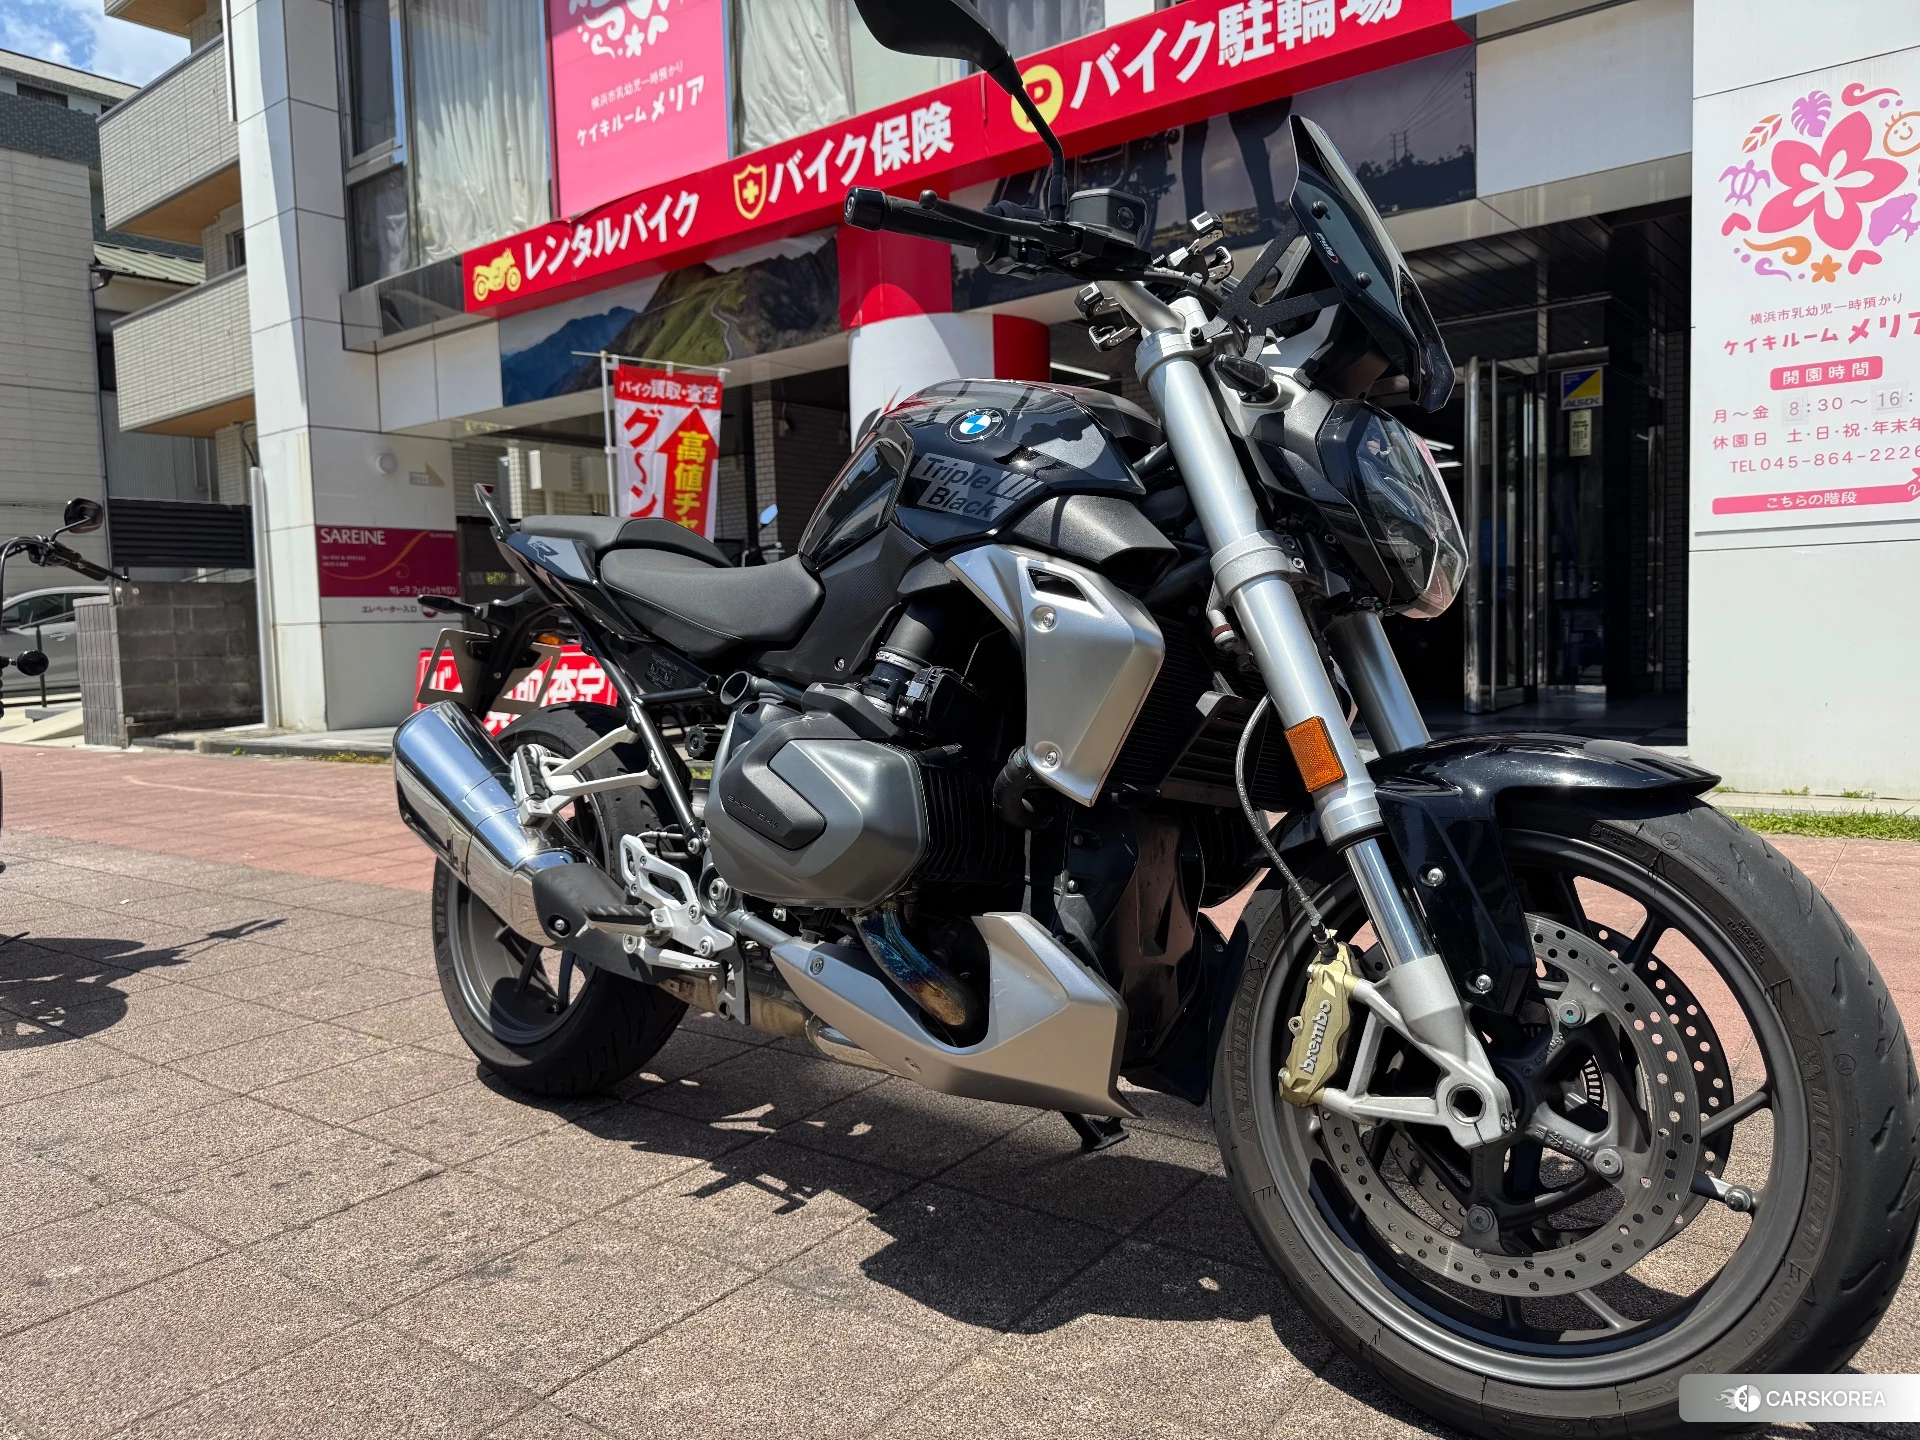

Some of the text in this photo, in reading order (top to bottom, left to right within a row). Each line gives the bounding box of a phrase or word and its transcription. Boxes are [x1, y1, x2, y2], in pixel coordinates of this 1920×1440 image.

[768, 101, 955, 204] バイク保険
[523, 190, 701, 281] レンタルバイク
[1749, 292, 1904, 326] 横浜市乳幼児一時預かり
[1782, 361, 1870, 386] 開園時間
[1712, 432, 1767, 451] 休園日
[921, 456, 993, 490] Triple
[926, 486, 999, 518] Black
[1766, 491, 1858, 509] こちらの階段
[320, 528, 386, 546] SAREINE
[362, 605, 418, 615] エレベーター入口
[1232, 974, 1258, 1103] MICHELIN
[1299, 999, 1332, 1076] brembo
[1562, 1138, 1595, 1161] BMW
[1801, 1086, 1832, 1254] MICHELIN
